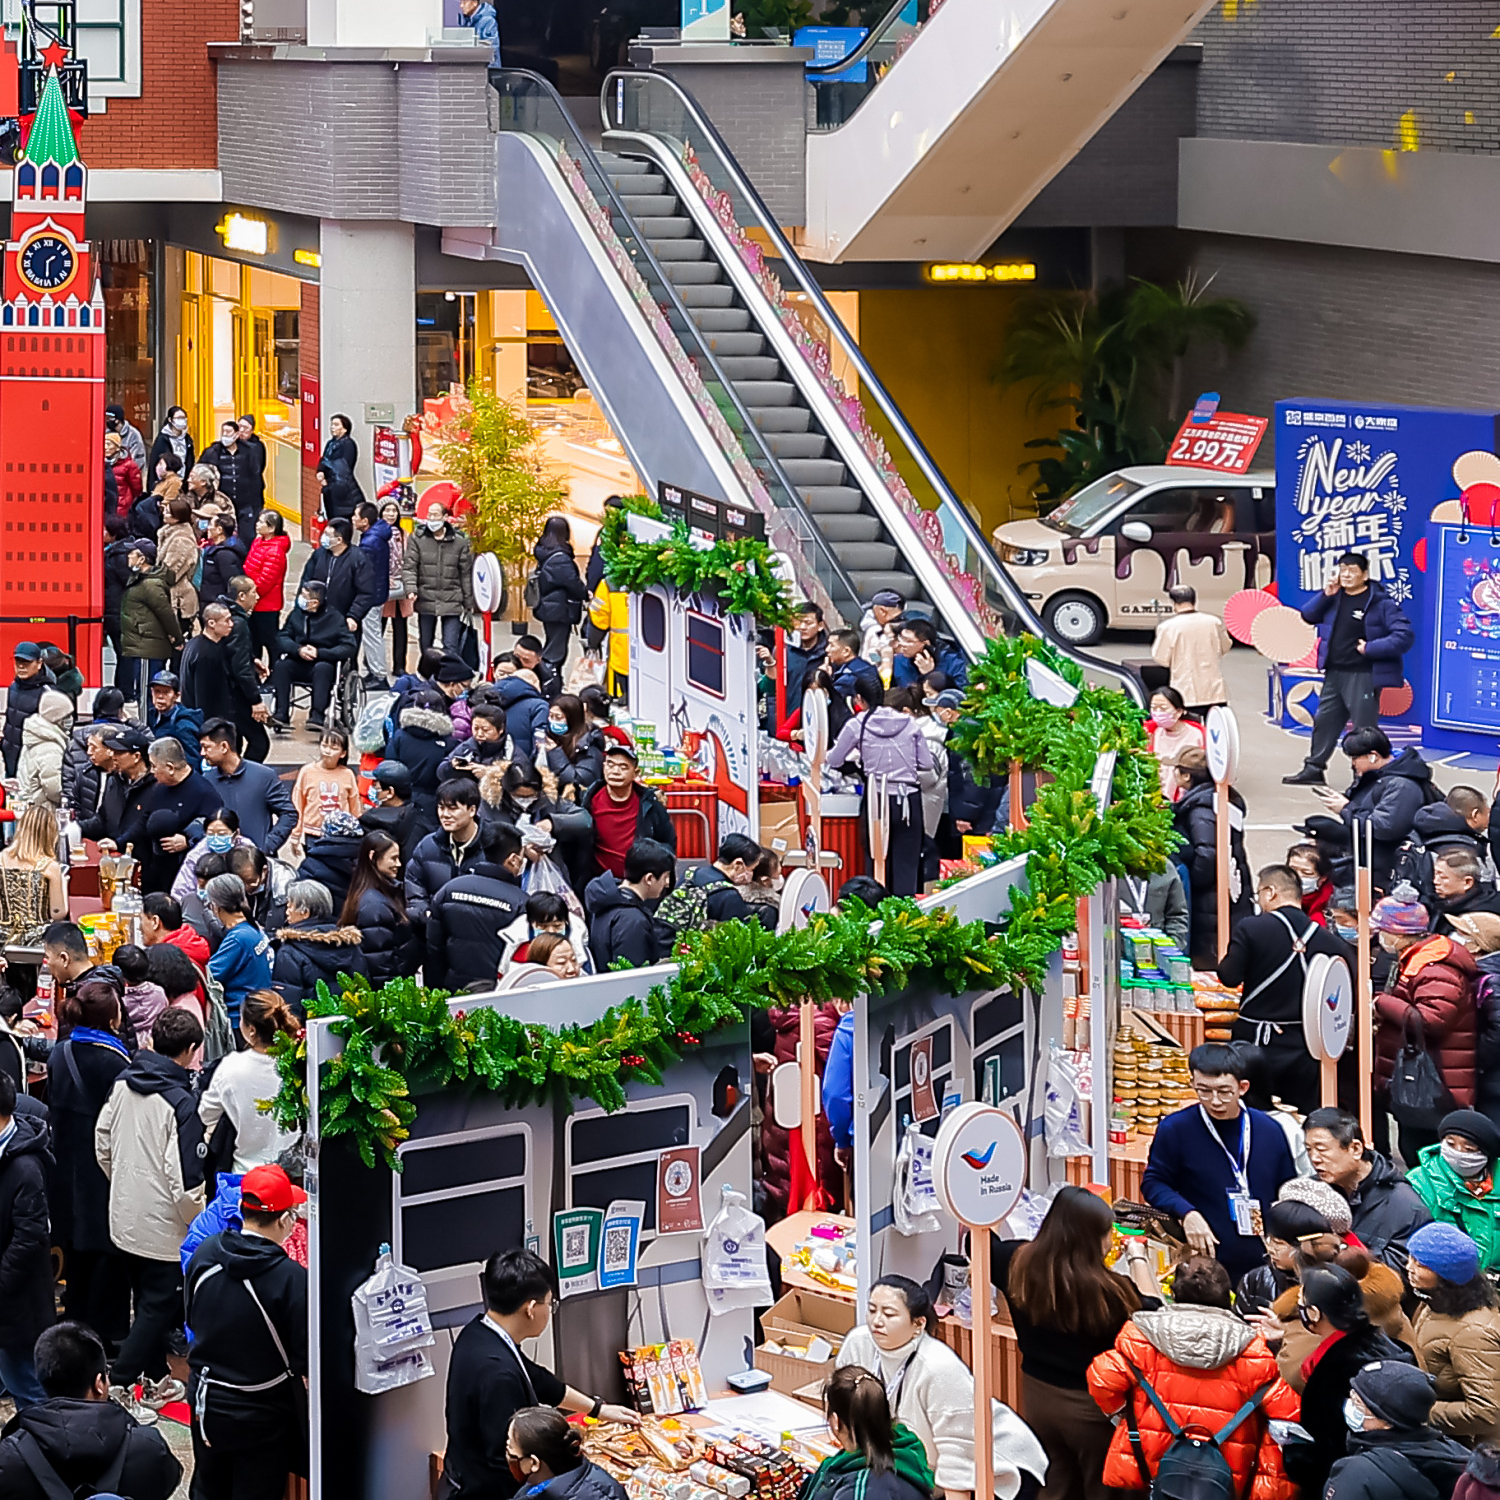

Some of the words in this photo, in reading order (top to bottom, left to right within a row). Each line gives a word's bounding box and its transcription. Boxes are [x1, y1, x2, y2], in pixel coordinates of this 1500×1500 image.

[1298, 437, 1398, 515] New
[1301, 490, 1383, 535] year
[1321, 513, 1389, 548] 新年
[980, 1175, 999, 1184] Made
[989, 1184, 1012, 1193] Russia
